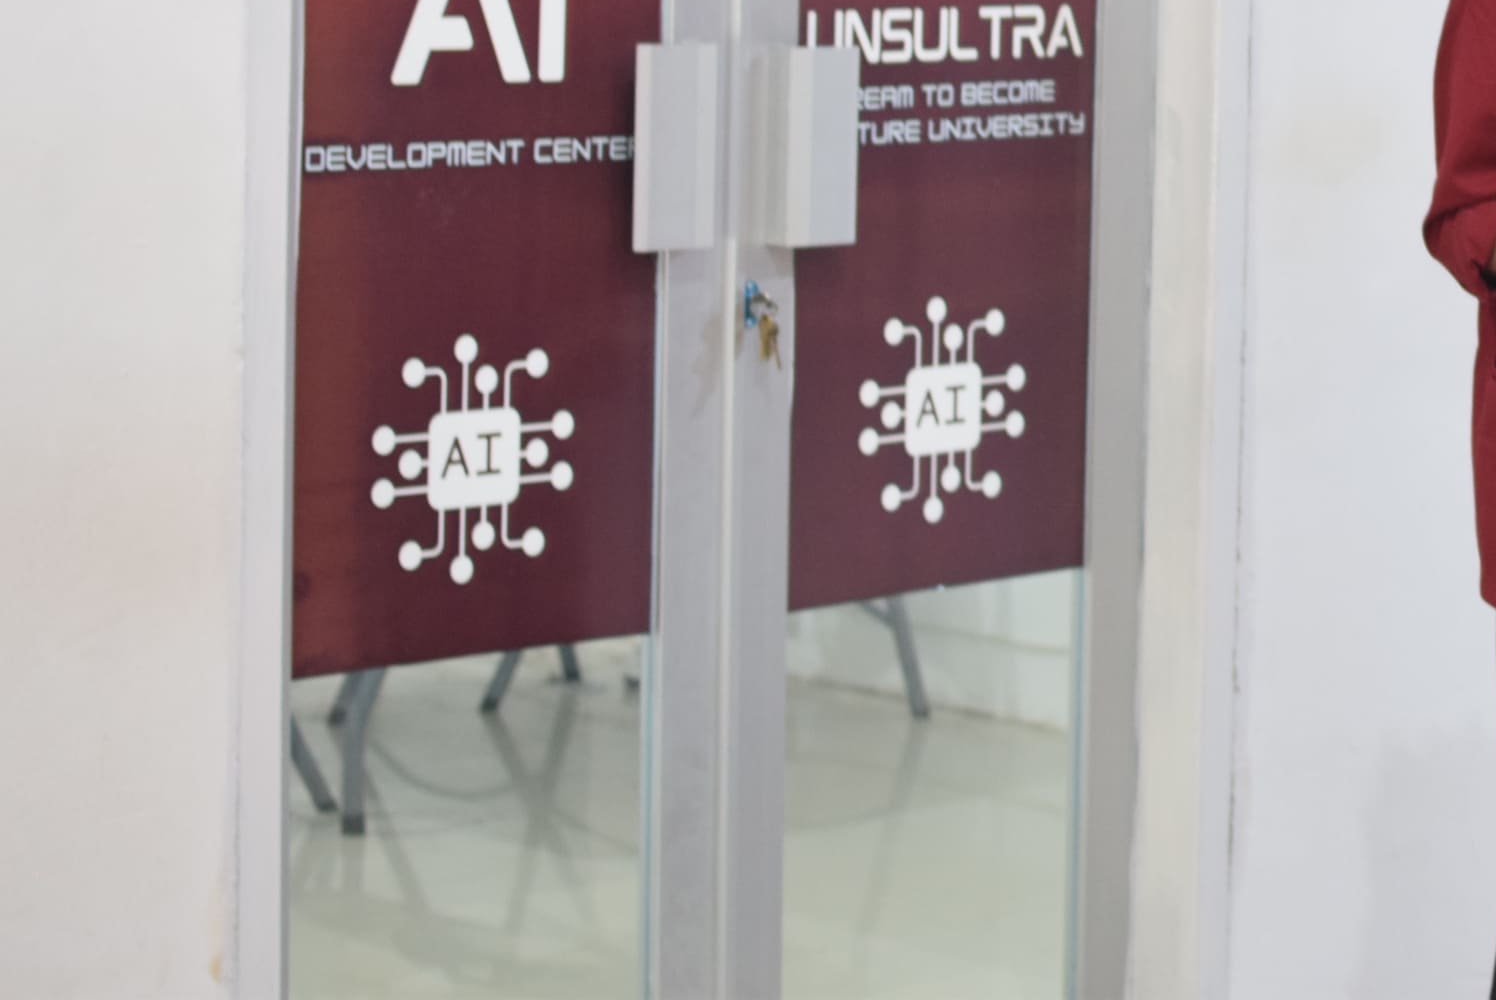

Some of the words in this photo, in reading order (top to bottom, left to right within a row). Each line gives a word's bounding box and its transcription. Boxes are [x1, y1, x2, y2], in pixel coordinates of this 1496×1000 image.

[922, 82, 955, 108] TO
[961, 79, 1056, 105] BECOME
[858, 118, 920, 145] TURE
[928, 112, 1086, 143] UNIVERSITY
[305, 138, 525, 173] DEVELOPMENT
[917, 384, 966, 428] AI
[441, 432, 502, 479] AI
